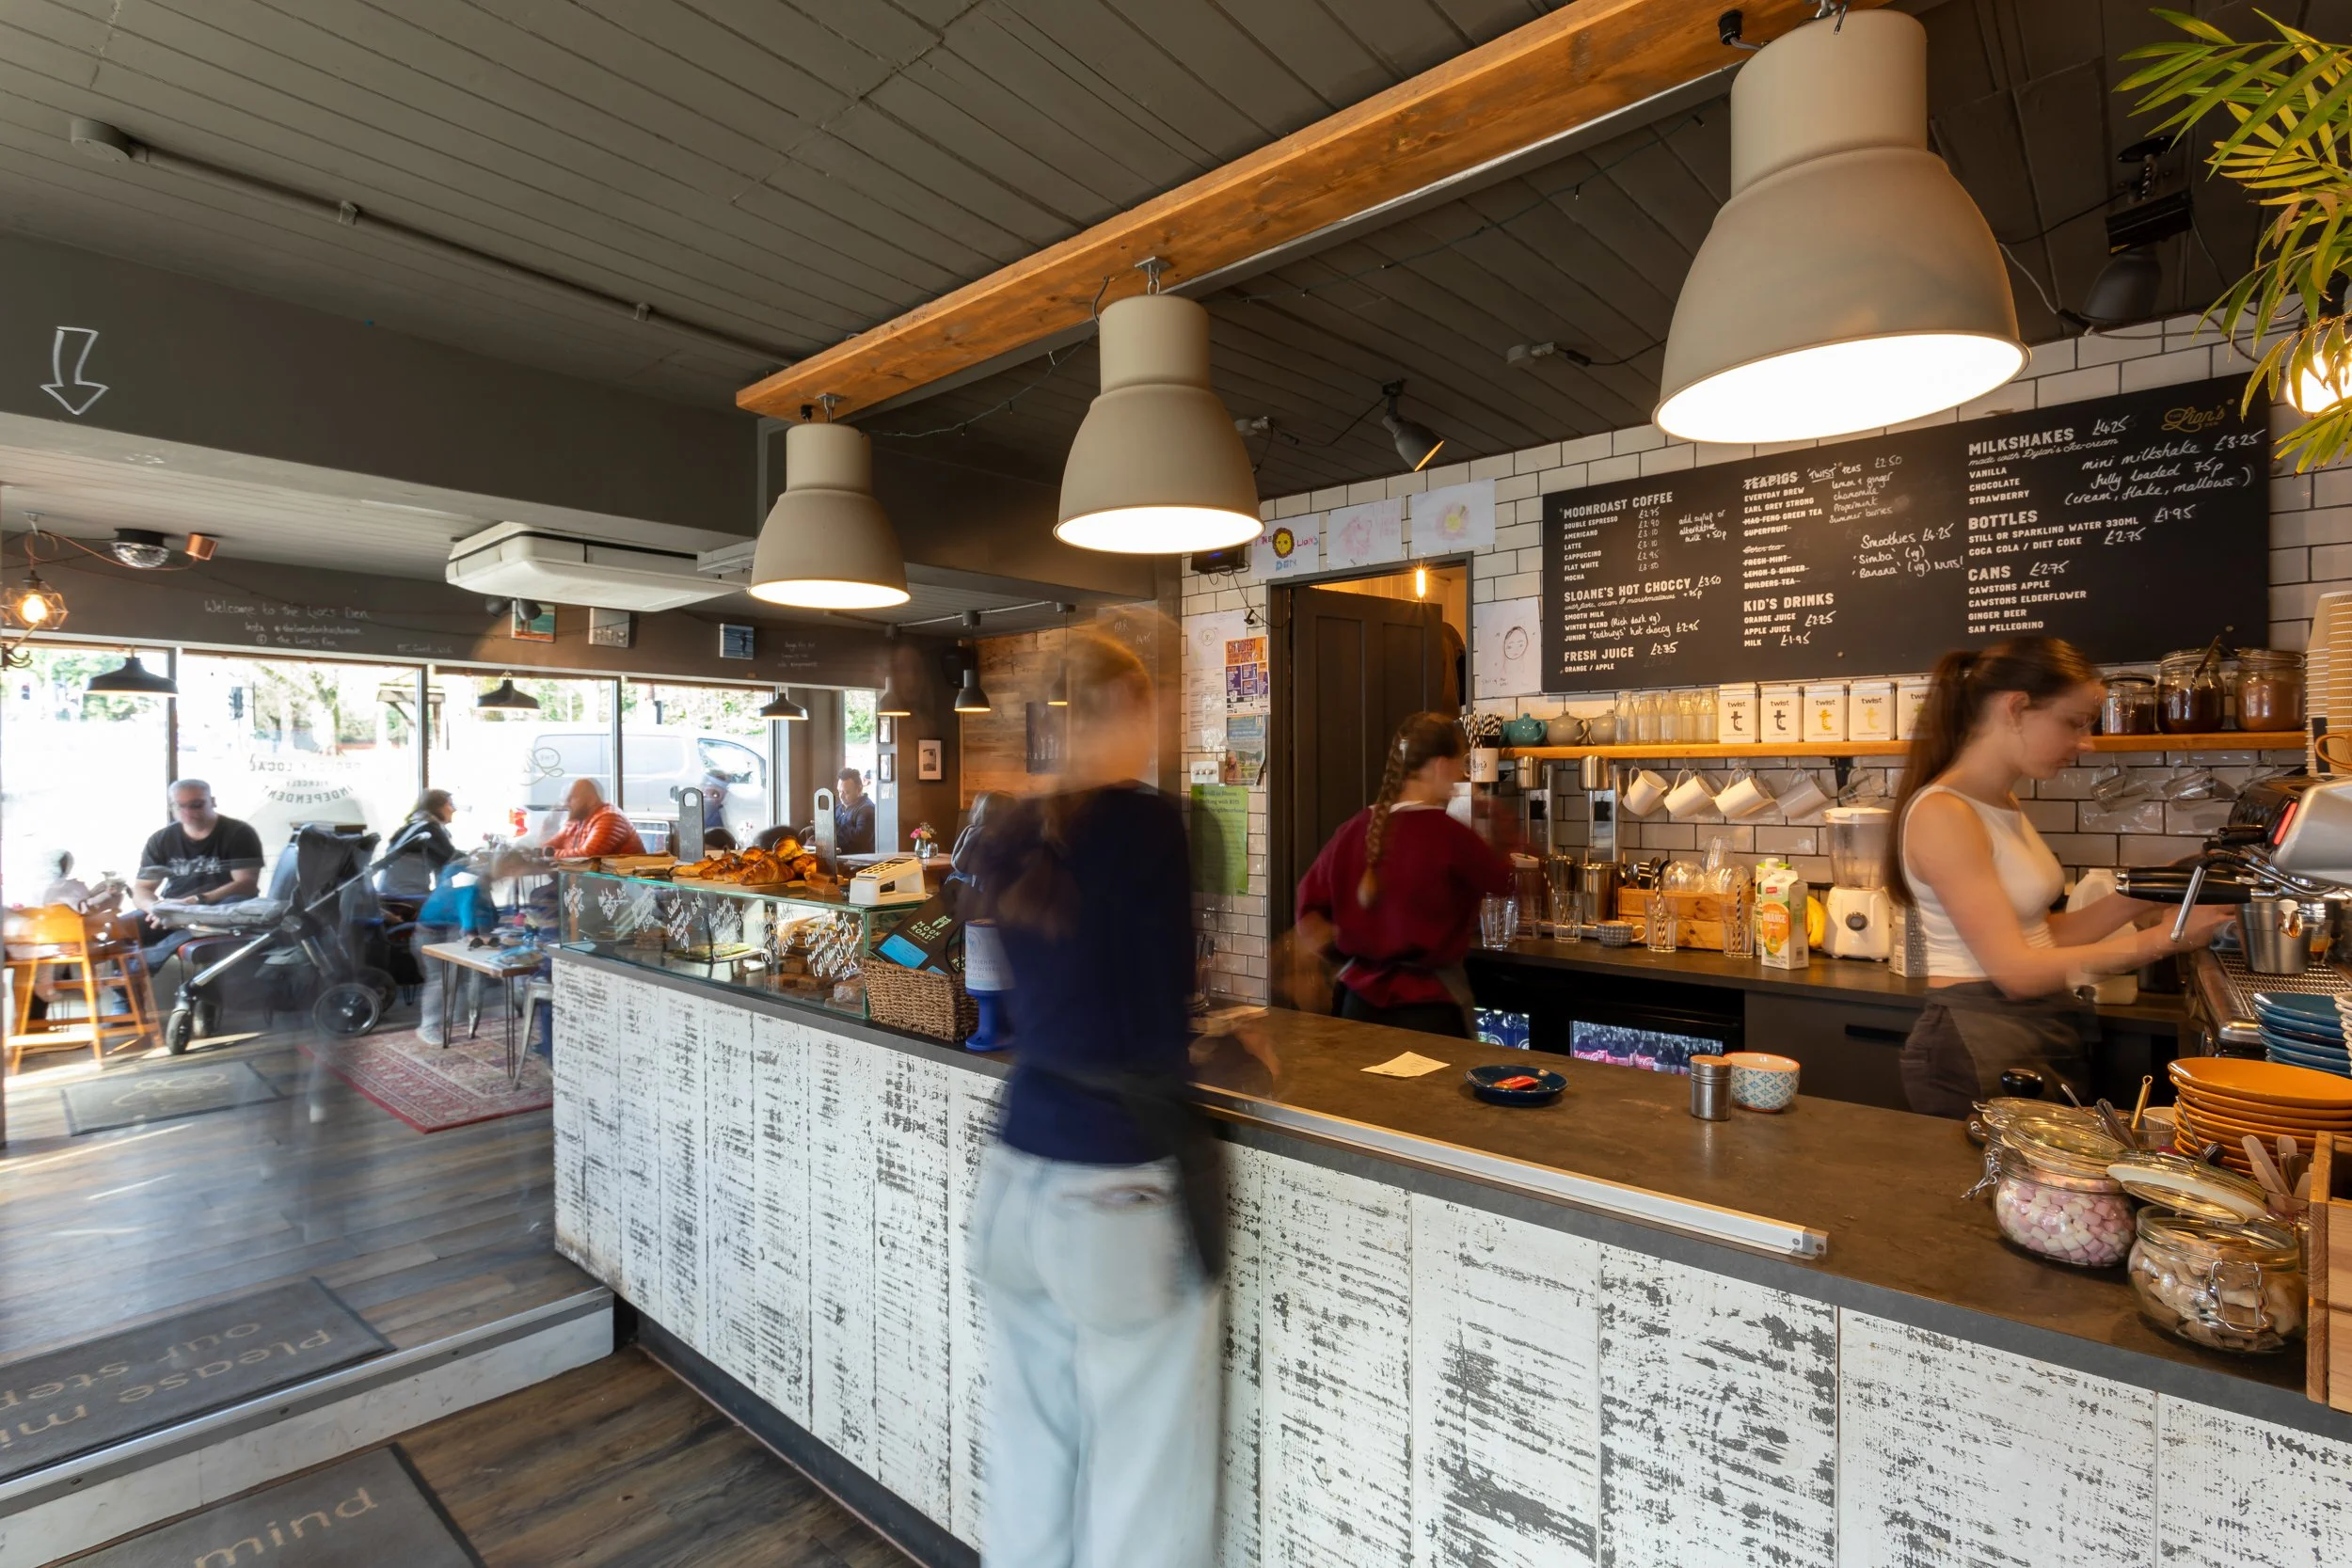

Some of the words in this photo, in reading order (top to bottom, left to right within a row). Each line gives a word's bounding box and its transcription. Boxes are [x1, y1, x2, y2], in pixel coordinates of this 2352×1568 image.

[1968, 427, 2074, 456] MILKSHAKES
[2081, 454, 2115, 470] mini
[2121, 439, 2201, 466] milkshake
[2214, 429, 2266, 451] £3.25
[1968, 457, 1994, 467] made
[1996, 452, 2020, 463] with
[2022, 445, 2062, 460] Dylan's
[2063, 438, 2119, 452] Ice-cream
[1875, 454, 1902, 468] £2.50
[1743, 471, 1799, 489] TEAPIGS
[1832, 480, 1856, 489] lemon
[1867, 471, 1894, 488] ginger
[1969, 467, 2007, 479] VANILLA
[2090, 473, 2122, 492] fully
[2130, 463, 2181, 482] loaded
[2194, 456, 2224, 477] 75p
[1969, 478, 2021, 492] CHOCOLATE
[2122, 482, 2169, 500] flake,
[1744, 490, 1781, 502] EVERYDAY
[1783, 486, 1805, 497] BREW
[1968, 490, 2030, 505] STRAWBERRY
[1564, 499, 1628, 519] MOONROAST
[1632, 491, 1674, 508] COFFEE
[1744, 503, 1762, 514] EARL
[1765, 500, 1784, 512] GREY
[1786, 497, 1815, 508] STRONG
[1678, 514, 1692, 525] add
[1694, 512, 1713, 526] syrup
[1762, 512, 1781, 523] FENG
[1782, 508, 1806, 520] GREEN
[1809, 507, 1823, 517] TEA
[1967, 510, 2039, 531] BOTTLES
[2153, 504, 2196, 523] £1.95
[1564, 518, 1586, 530] DOUBLE
[1588, 515, 1618, 527] ESPRESSO
[1743, 524, 1789, 537] SUPERFRUIT
[1968, 533, 1994, 544] STILL
[1996, 531, 2010, 541] OR
[2012, 525, 2065, 539] SPARKLING
[2069, 520, 2102, 532] WATER
[2106, 516, 2139, 528] 330ML
[1564, 529, 1598, 540] AMERICANO
[1861, 531, 1916, 549] Smoothies
[1922, 523, 1955, 542] £4.25
[2104, 527, 2146, 546] £2.75
[1564, 542, 1582, 551] LATTE
[1905, 545, 1925, 560] (vg)
[1968, 546, 1993, 557] COCA
[1995, 544, 2020, 554] COLA
[2032, 540, 2054, 550] DIET
[2057, 536, 2083, 547] COKE
[1564, 550, 1602, 562] CAPPUCCINO
[1743, 557, 1767, 566] FRESH
[1769, 554, 1788, 563] MINT
[1564, 563, 1579, 572] FLAT
[1581, 561, 1599, 570] WHITE
[1743, 568, 1768, 578] LEMON
[1778, 564, 1806, 575] GINGER
[1967, 565, 2011, 581] CANS
[2029, 560, 2070, 577] £2.75
[1564, 574, 1585, 582] MOCHA
[1744, 579, 1780, 590] BUILDERS
[1781, 578, 1795, 586] TEA
[1564, 588, 1614, 603] SLOANE'S
[1618, 583, 1641, 596] HOT
[1645, 578, 1692, 594] CHOCCY
[1968, 583, 2018, 594] CAWSTONS
[2021, 579, 2051, 591] APPLE
[1743, 597, 1778, 612] KID'S
[1783, 593, 1835, 610] DRINKS
[1968, 595, 2018, 608] CAWSTONS
[2021, 590, 2088, 604] ELDERFLOWER
[204, 600, 256, 617] Welcome
[262, 603, 276, 615] to
[1565, 611, 1588, 621] SMOOTH
[1968, 611, 2001, 621] GINGER
[2004, 609, 2027, 618] BEER
[1589, 621, 1609, 629] BLEND
[1630, 613, 1646, 625] dark
[1743, 615, 1772, 625] ORANGE
[1774, 612, 1796, 622] JUICE
[1629, 626, 1644, 636] hot
[1645, 625, 1671, 638] choccy
[1744, 626, 1767, 636] APPLE
[1769, 625, 1791, 634] JUICE
[1968, 625, 1987, 634] SAN
[1989, 621, 2044, 633] PELLEGRINO
[1565, 633, 1586, 641] JUNIOR
[1744, 639, 1762, 647] MILK
[1780, 631, 1811, 647] £1.95
[1564, 649, 1597, 662] FRESH
[1601, 646, 1634, 659] JUICE
[1565, 663, 1588, 673] ORANGE
[1595, 662, 1615, 671] APPLE
[910, 924, 935, 942] ROAST
[916, 921, 942, 937] MOON
[158, 1323, 262, 1362] our
[118, 1328, 333, 1403] Please
[195, 1487, 378, 1568] mind
